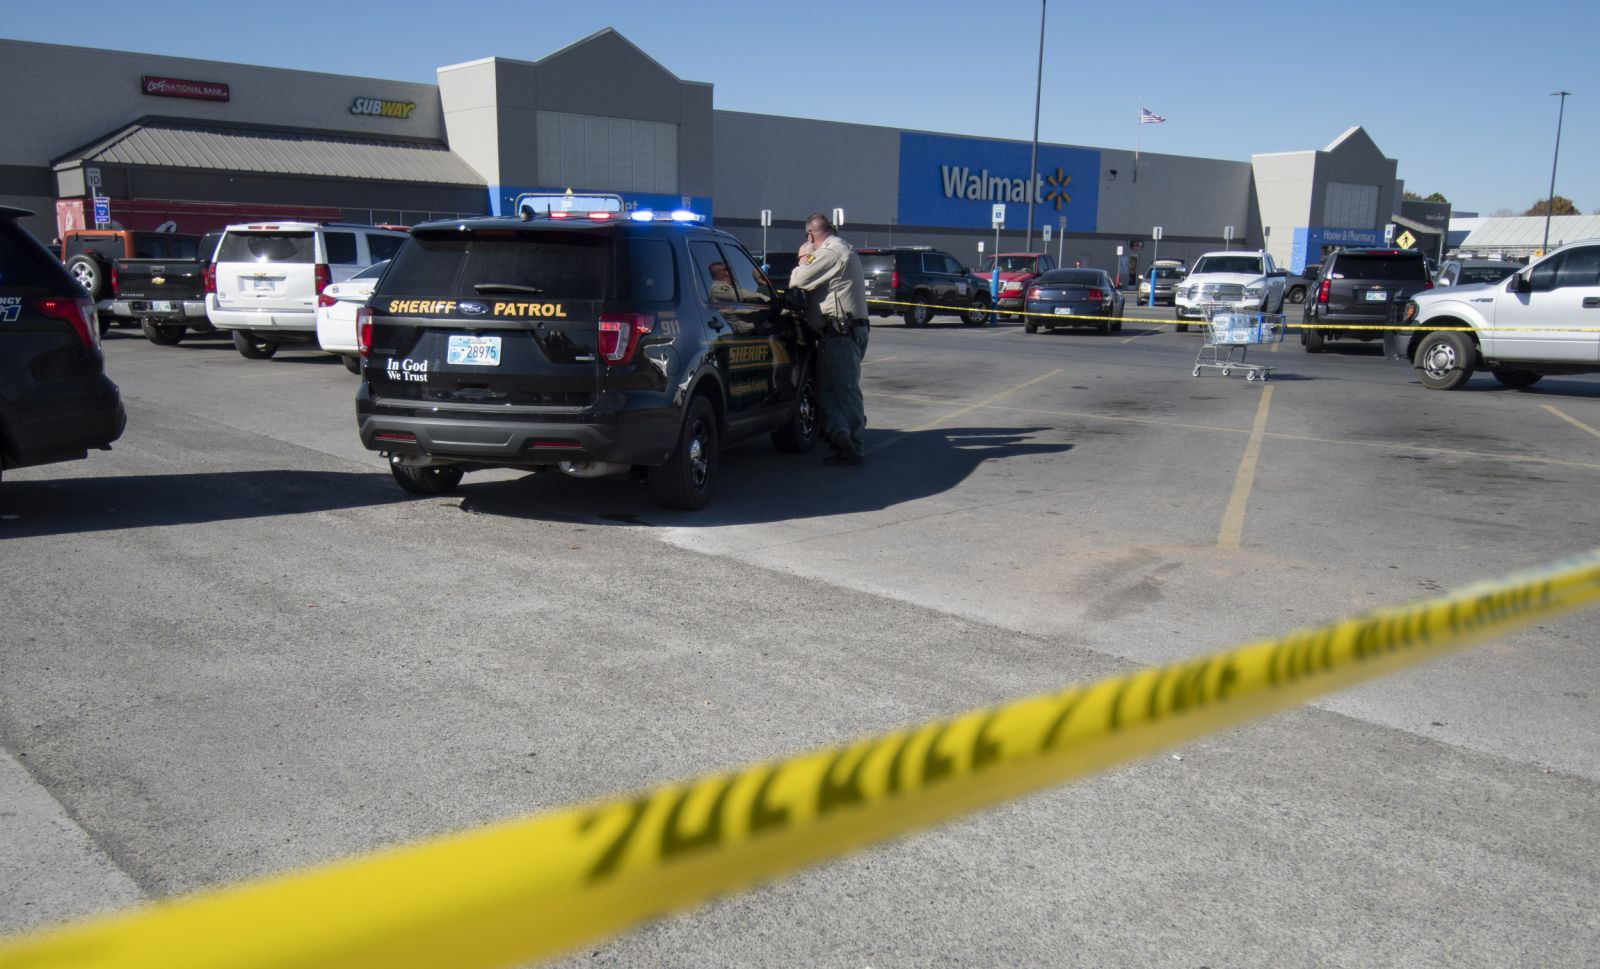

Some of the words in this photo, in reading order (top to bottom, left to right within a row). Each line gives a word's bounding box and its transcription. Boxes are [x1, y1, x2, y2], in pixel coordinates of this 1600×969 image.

[351, 98, 416, 118] SUBWAY
[90, 175, 100, 185] 10
[942, 165, 1044, 203] Walmart
[1323, 230, 1341, 241] Home
[1348, 231, 1376, 244] Pharmacy
[389, 300, 457, 314] SHERIFF
[493, 303, 567, 317] PATROL
[661, 320, 681, 336] 911
[466, 345, 497, 359] 28975
[729, 345, 769, 363] SHERIFF
[387, 358, 399, 371] In
[402, 358, 428, 372] God
[387, 371, 401, 380] We
[402, 371, 428, 382] Trust
